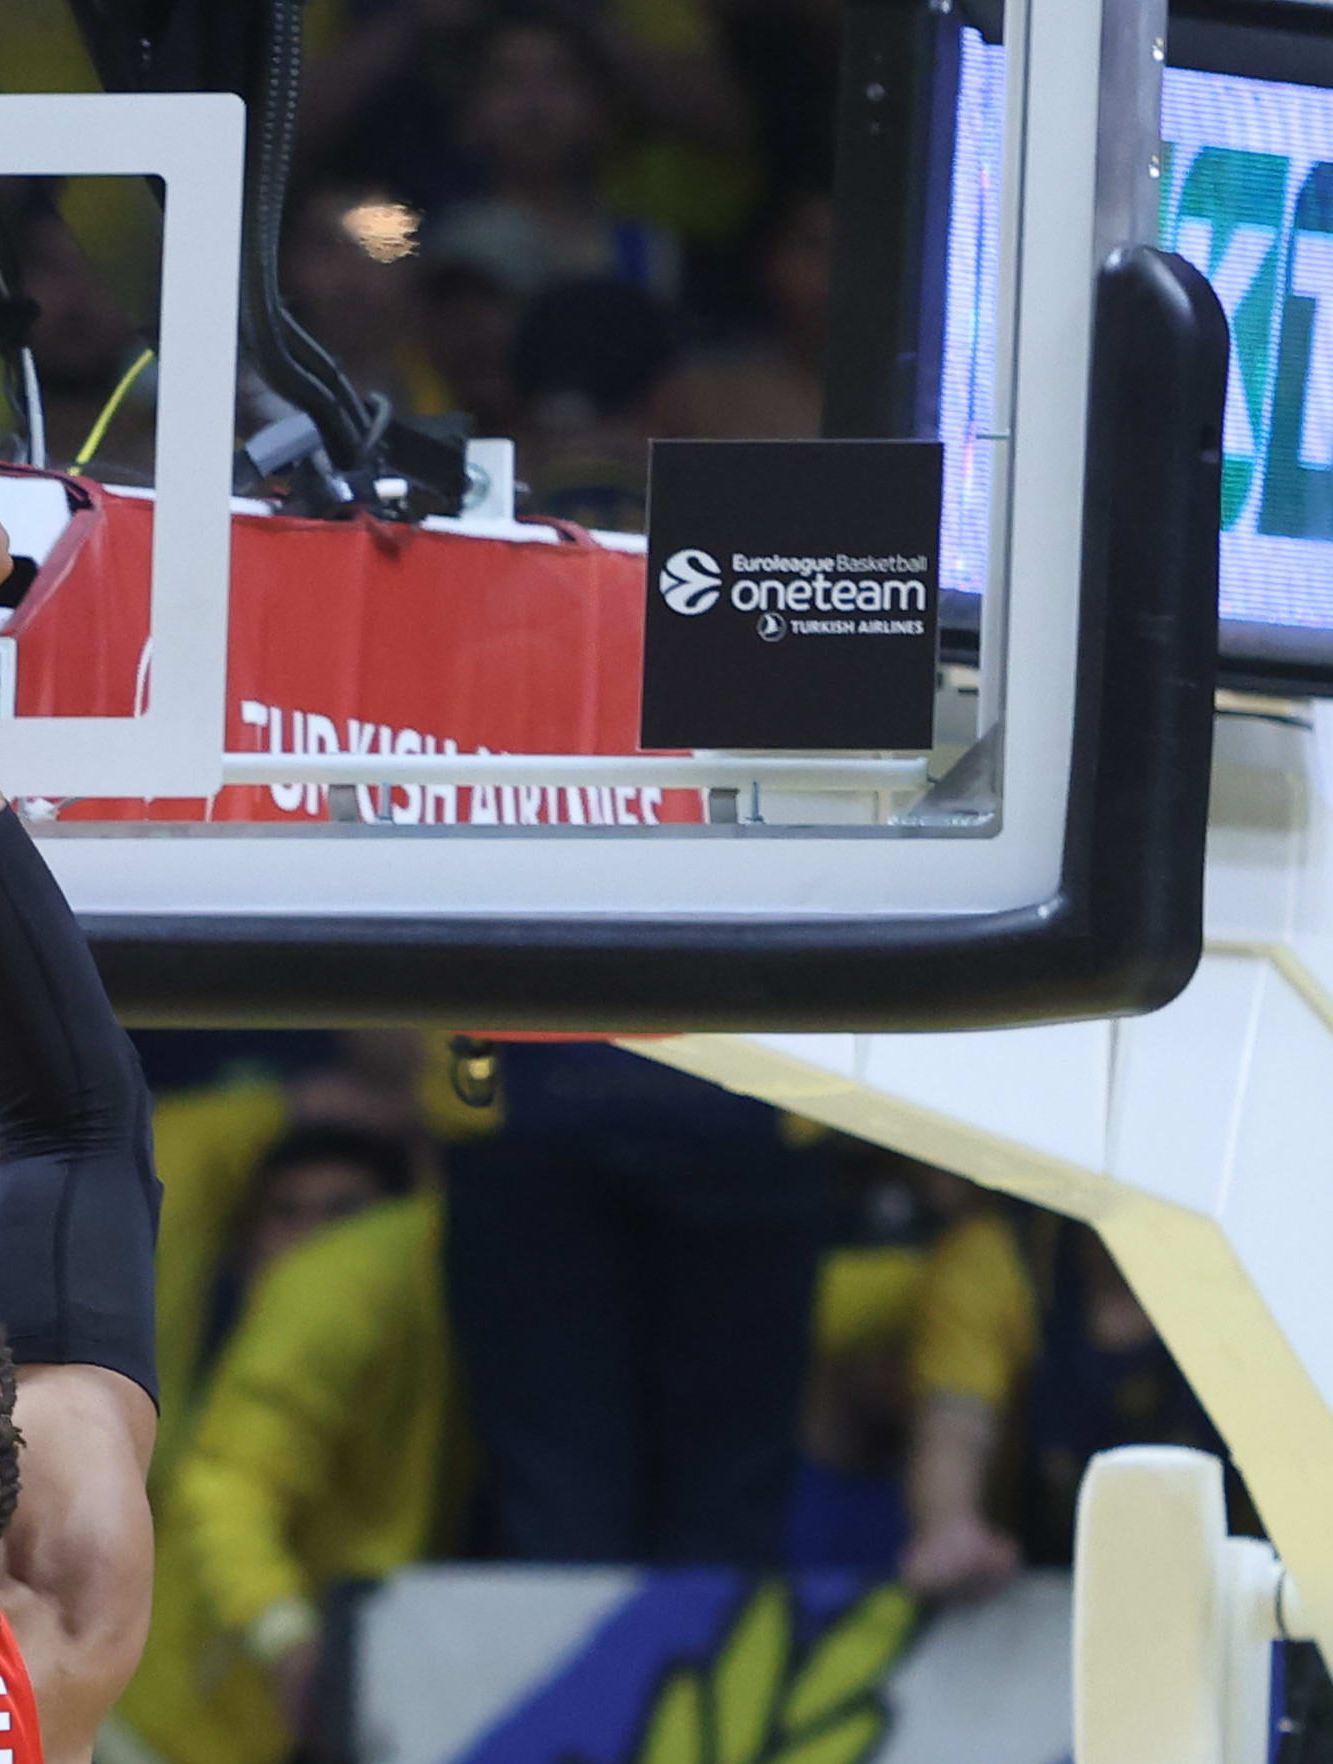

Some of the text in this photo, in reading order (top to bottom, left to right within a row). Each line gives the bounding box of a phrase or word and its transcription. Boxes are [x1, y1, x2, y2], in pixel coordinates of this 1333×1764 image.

[732, 553, 928, 577] Euroleague Basketball
[731, 574, 927, 611] oneteam
[790, 619, 925, 635] TURKISH AIRLINES
